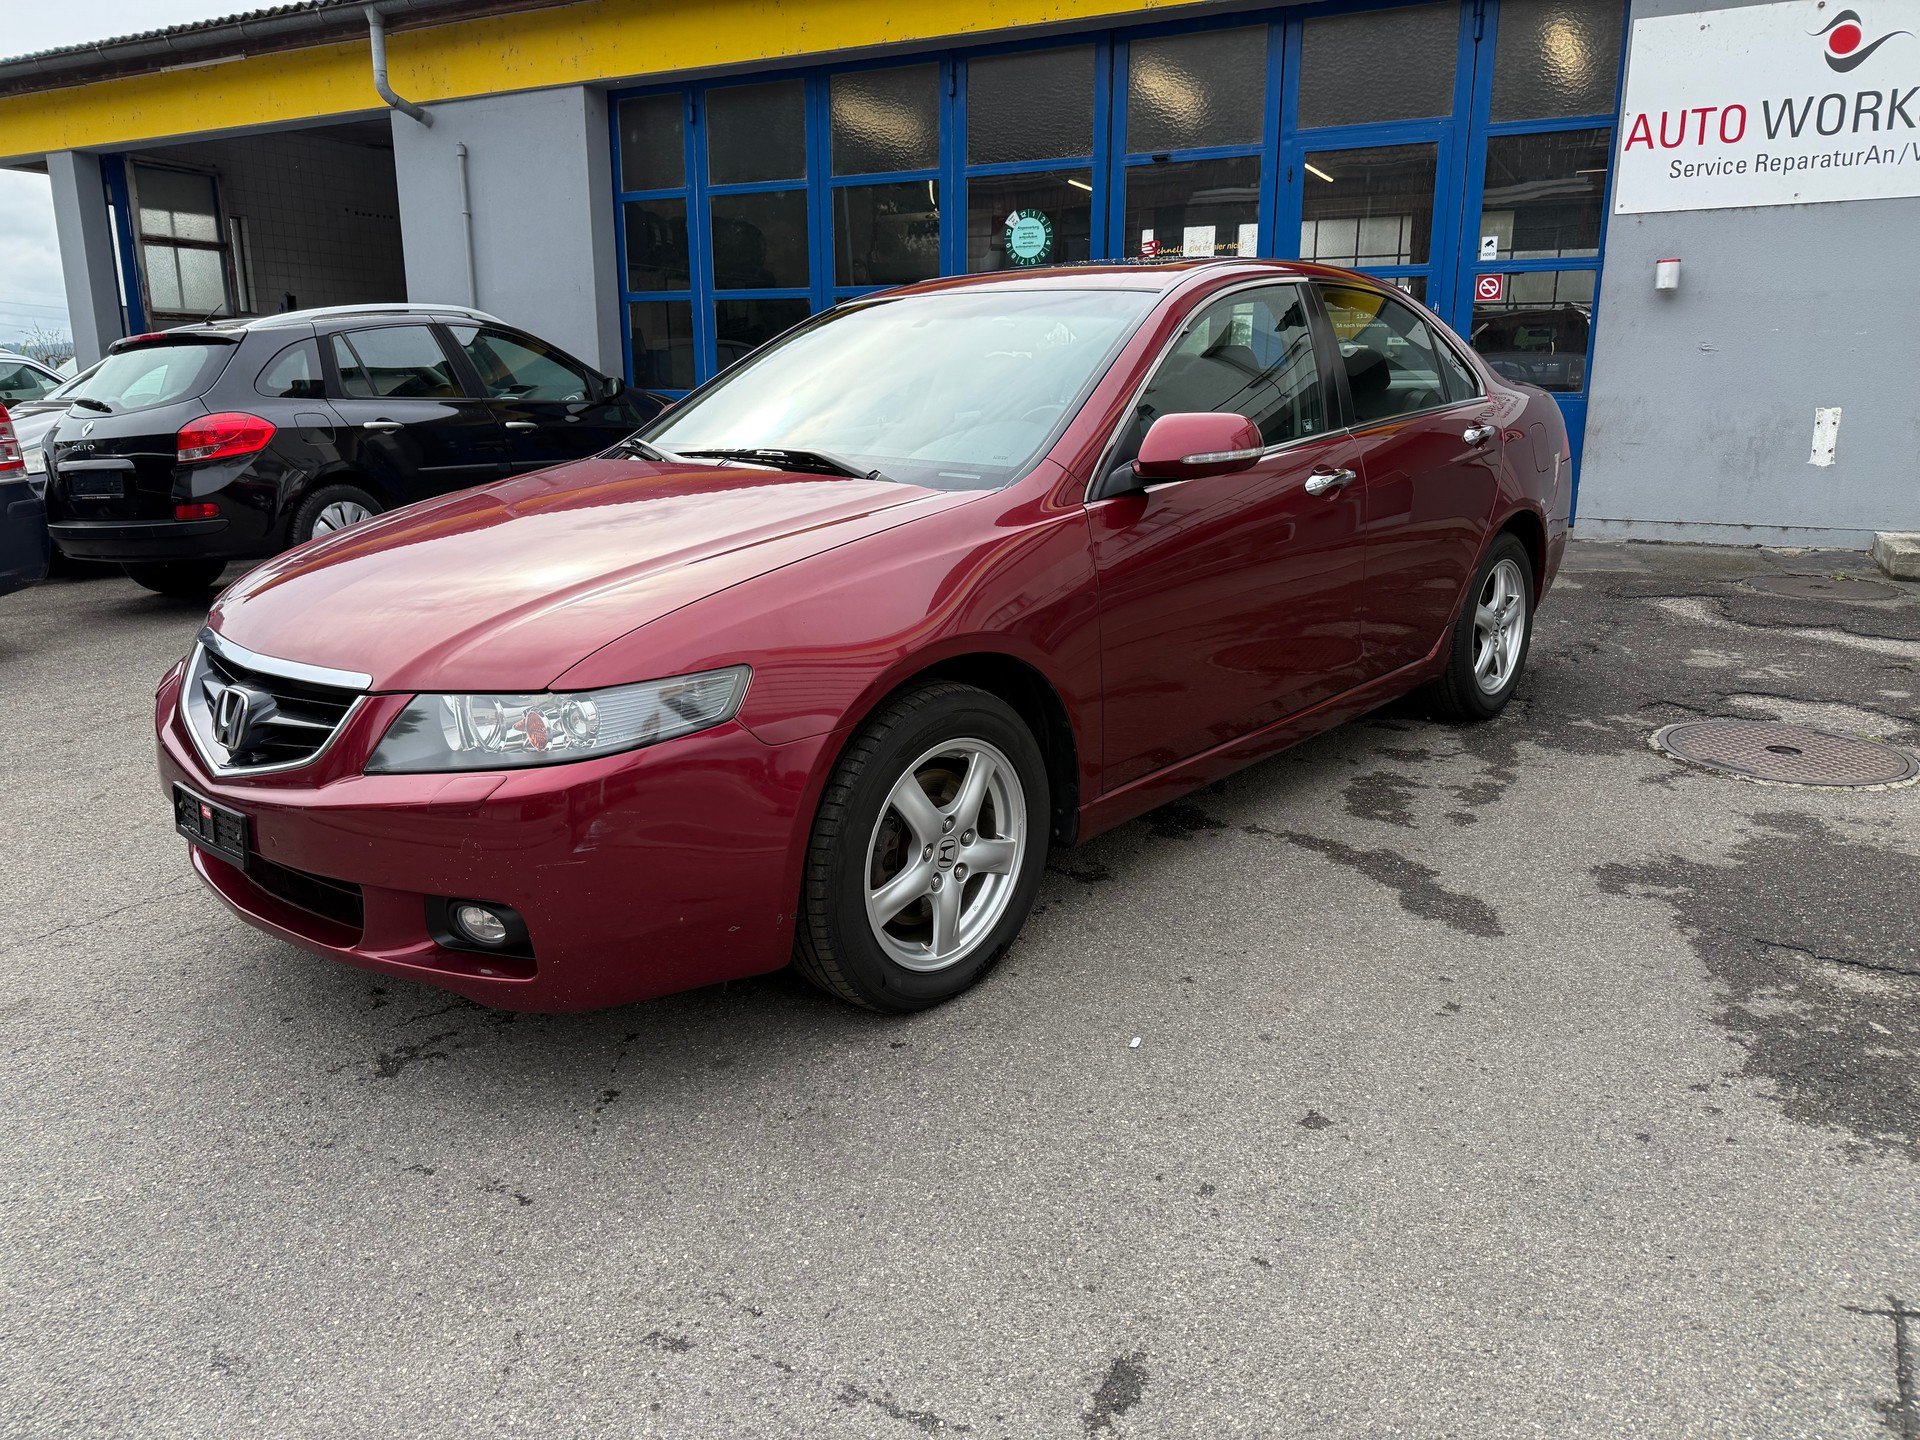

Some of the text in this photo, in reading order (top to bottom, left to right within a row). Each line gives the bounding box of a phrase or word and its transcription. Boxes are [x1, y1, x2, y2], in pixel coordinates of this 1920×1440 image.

[1624, 86, 1920, 151] AUTO WORK
[1669, 156, 1747, 179] Service
